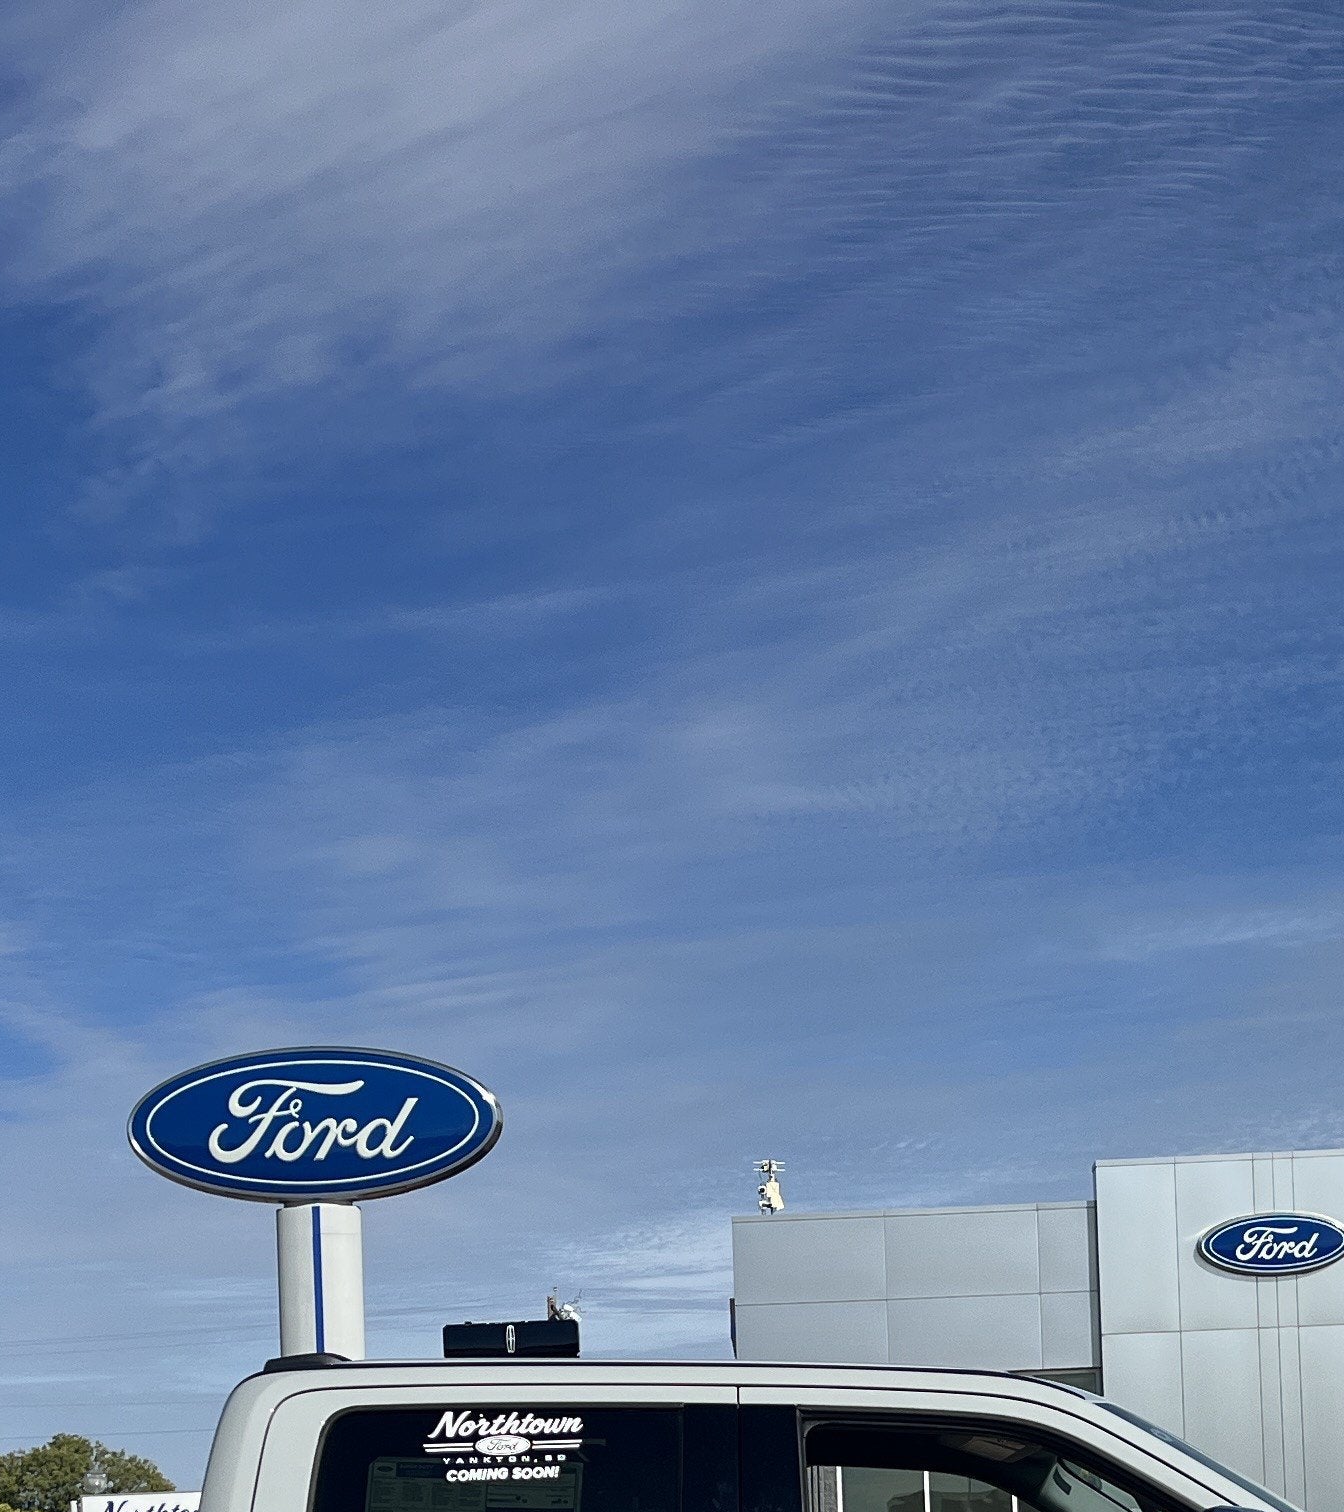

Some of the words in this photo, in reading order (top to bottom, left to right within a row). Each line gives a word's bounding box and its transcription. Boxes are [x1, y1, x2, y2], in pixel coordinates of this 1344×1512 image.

[208, 1079, 419, 1164] Ford
[1235, 1226, 1320, 1261] Ford
[427, 1410, 584, 1439] Northtown
[486, 1438, 519, 1451] Ford
[445, 1468, 509, 1482] COMING
[511, 1465, 561, 1480] SOON!
